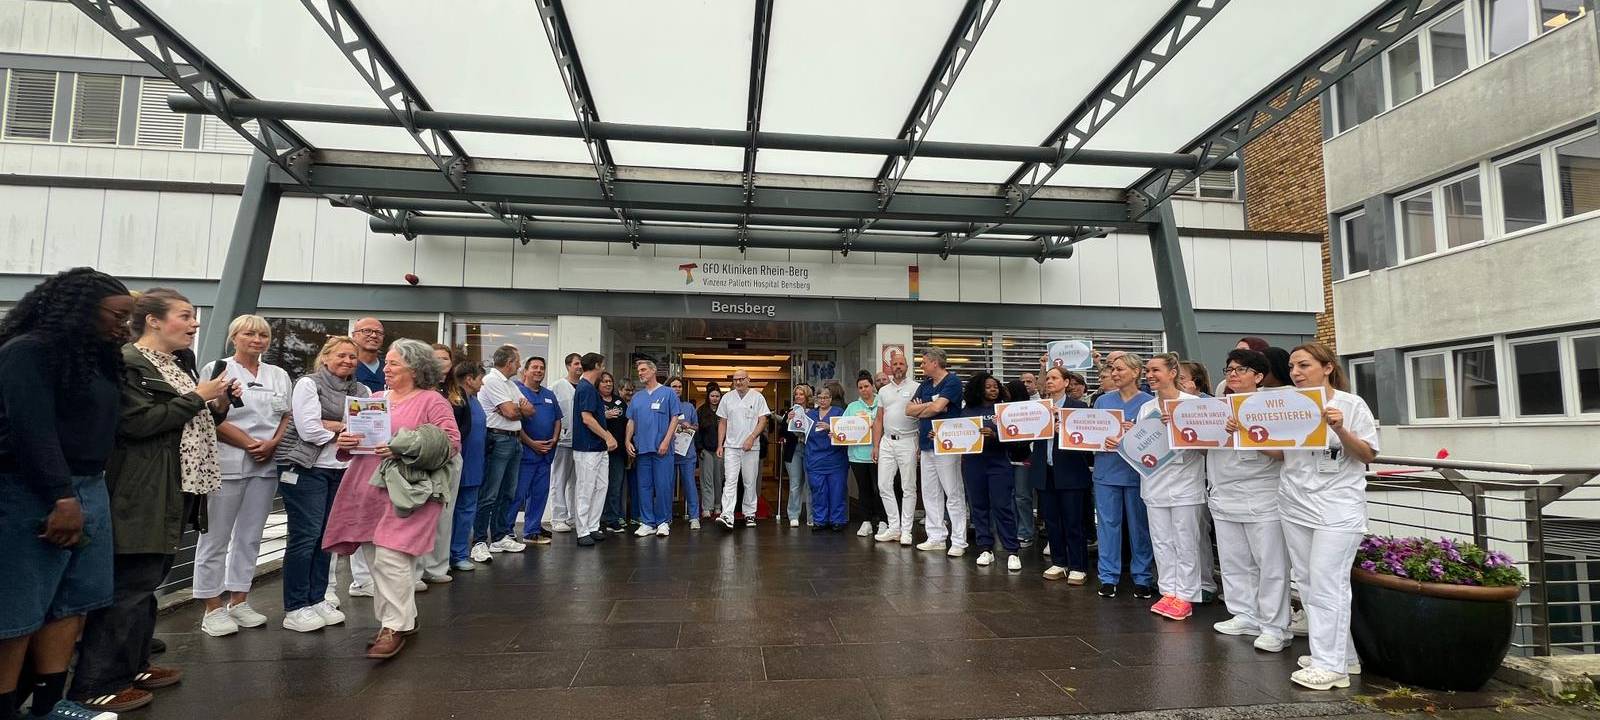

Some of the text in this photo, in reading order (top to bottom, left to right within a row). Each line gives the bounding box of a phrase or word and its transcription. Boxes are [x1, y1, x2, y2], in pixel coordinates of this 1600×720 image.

[702, 263, 809, 279] GFO Kliniken Rhein-Berg
[702, 278, 811, 290] Vinzenz Pallotti Hospital Bensberg
[711, 301, 776, 317] Bensberg
[1265, 399, 1285, 408] WIR
[1245, 410, 1312, 422] PROTESTIEREN
